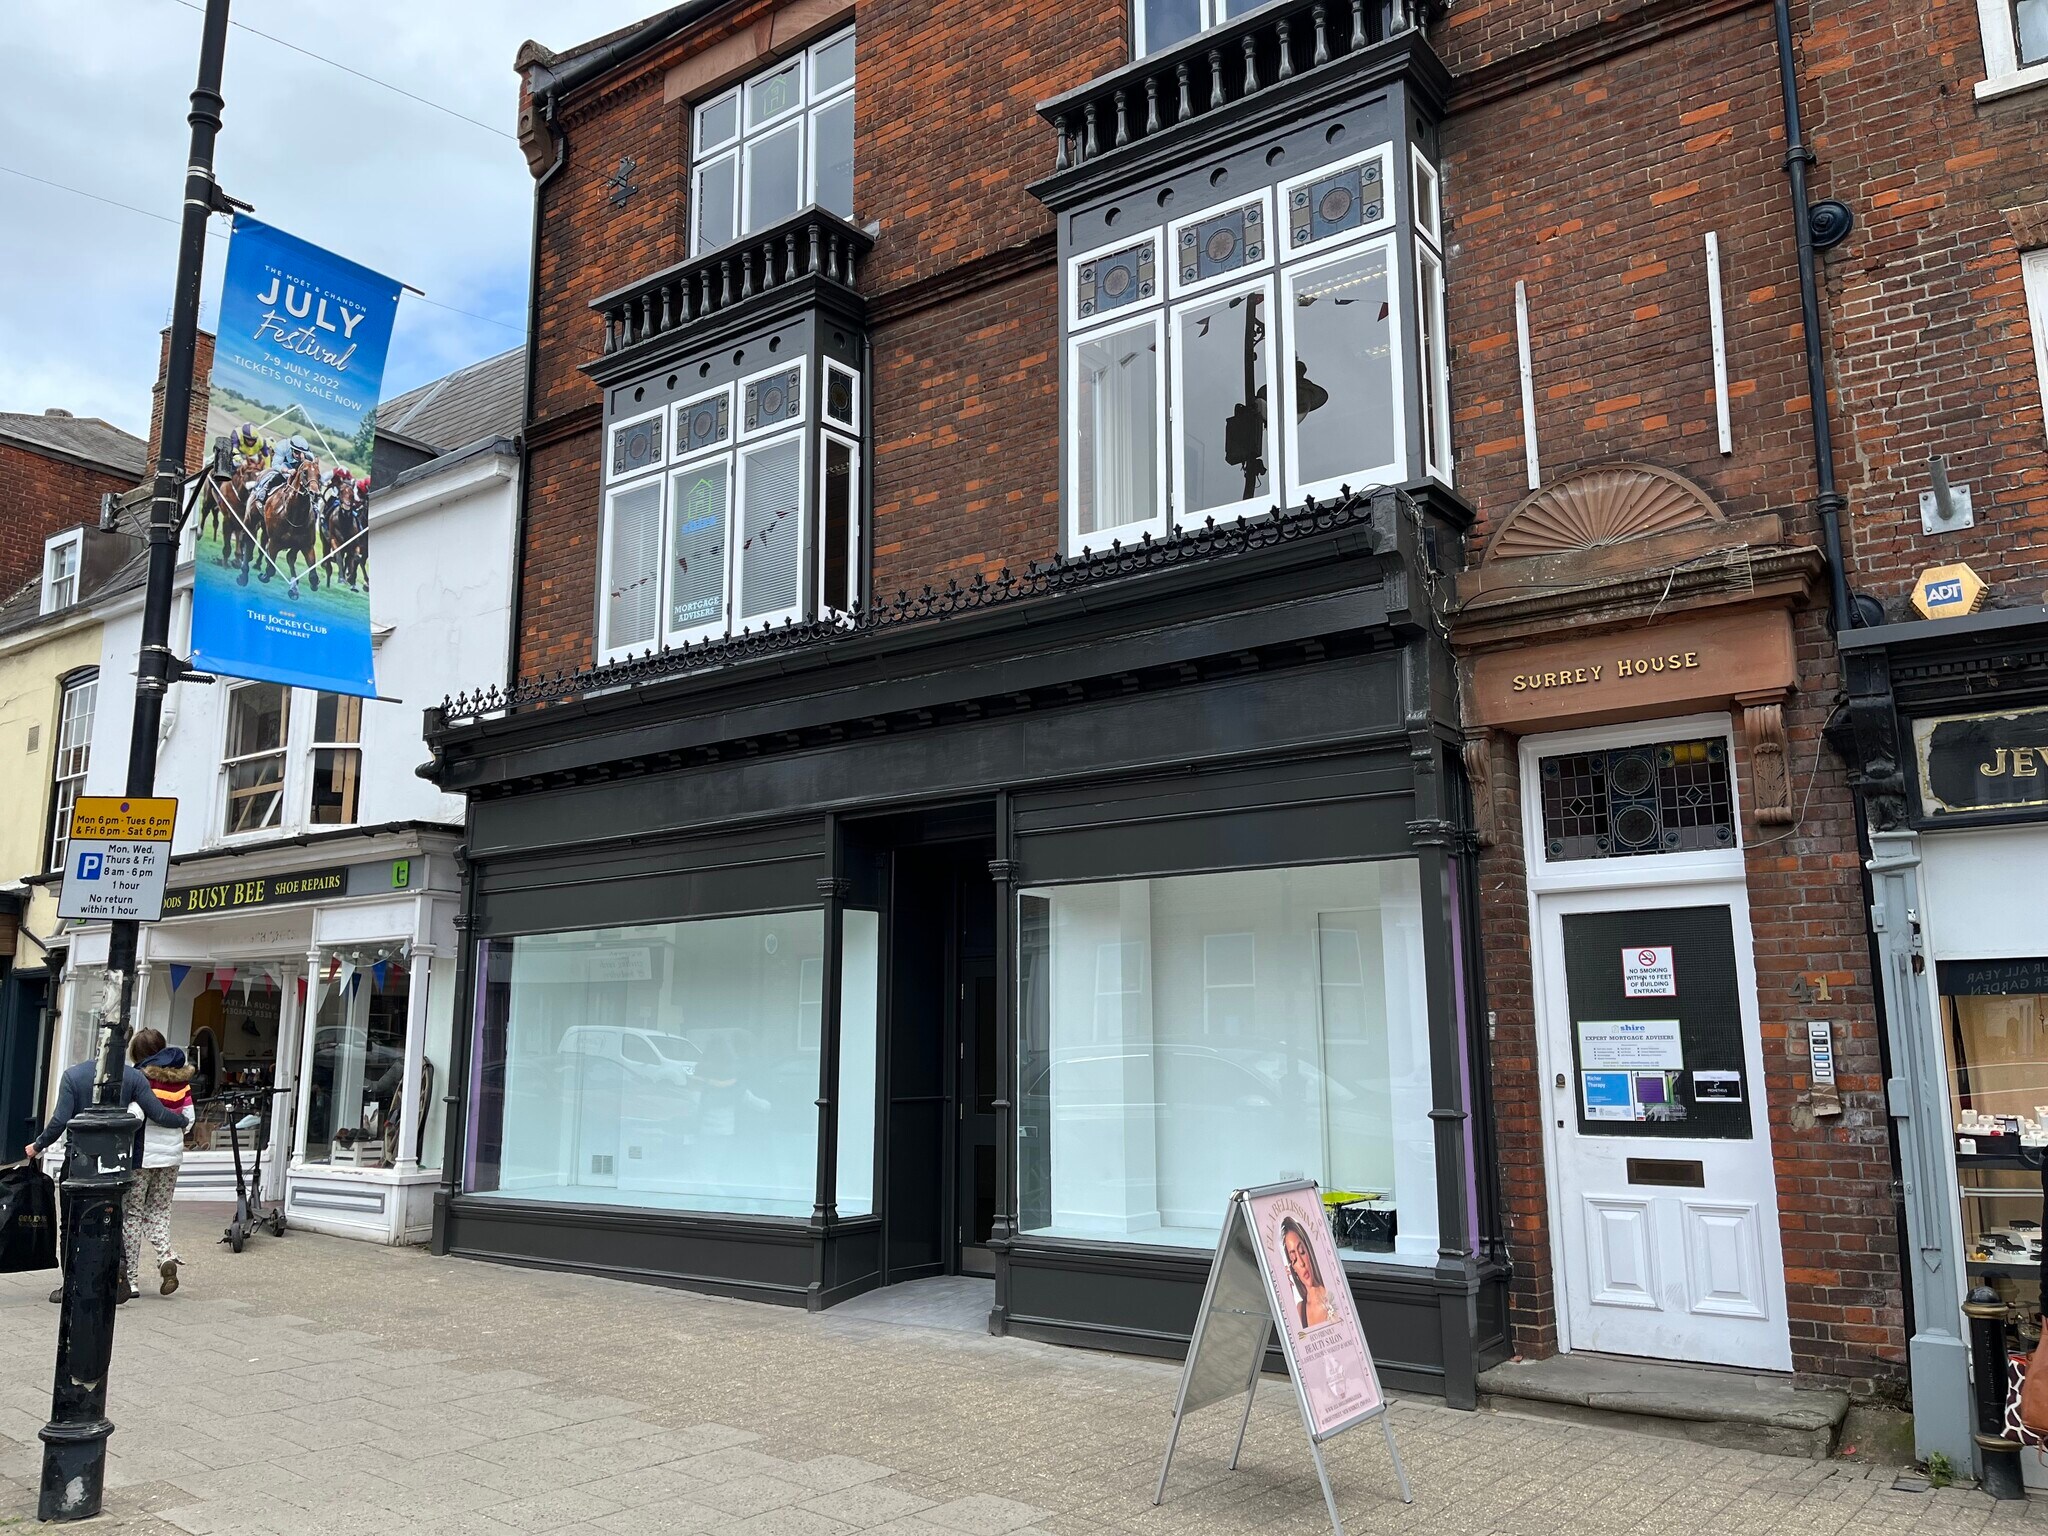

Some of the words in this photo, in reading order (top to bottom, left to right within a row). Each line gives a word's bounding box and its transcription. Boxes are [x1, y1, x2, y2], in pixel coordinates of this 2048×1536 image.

[264, 265, 282, 277] THE
[324, 290, 367, 313] CHANDON
[256, 277, 365, 339] JULY
[253, 309, 358, 371] Festival
[263, 352, 281, 366] 7-9
[283, 362, 311, 378] JULY
[312, 373, 340, 390] 2022
[234, 354, 281, 380] TICKETS
[284, 375, 302, 388] ON
[304, 382, 333, 400] SALE
[334, 394, 362, 412] NOW
[1927, 582, 1961, 603] ADT
[674, 596, 719, 614] MORTGAGE
[678, 607, 714, 622] ADVISERS
[246, 609, 266, 622] THE
[268, 614, 301, 629] JOCKEY
[302, 622, 328, 635] CLUB
[265, 625, 310, 639] NEWMARKET
[1512, 665, 1603, 692] SURREY
[1617, 652, 1699, 678] HOUSE
[76, 816, 95, 824] Mon
[126, 816, 146, 825] Tues
[76, 826, 82, 834] &
[85, 826, 97, 835] Fri
[127, 827, 143, 836] Sat
[82, 855, 100, 878] P
[105, 855, 131, 864] Thurs
[133, 856, 139, 864] &
[142, 856, 155, 865] Fri
[112, 881, 117, 889] 1
[119, 881, 141, 890] hour
[187, 885, 230, 911] BUSY
[233, 880, 266, 906] BEE
[274, 880, 299, 895] SHOE
[300, 874, 341, 892] REPAIRS
[80, 904, 108, 914] within
[111, 906, 115, 914] 1
[118, 906, 139, 915] hour
[89, 894, 102, 903] No
[104, 896, 133, 904] return
[1788, 974, 1832, 1003] 41
[1305, 1339, 1326, 1354] BEAUTY
[1325, 1333, 1343, 1346] SALON
